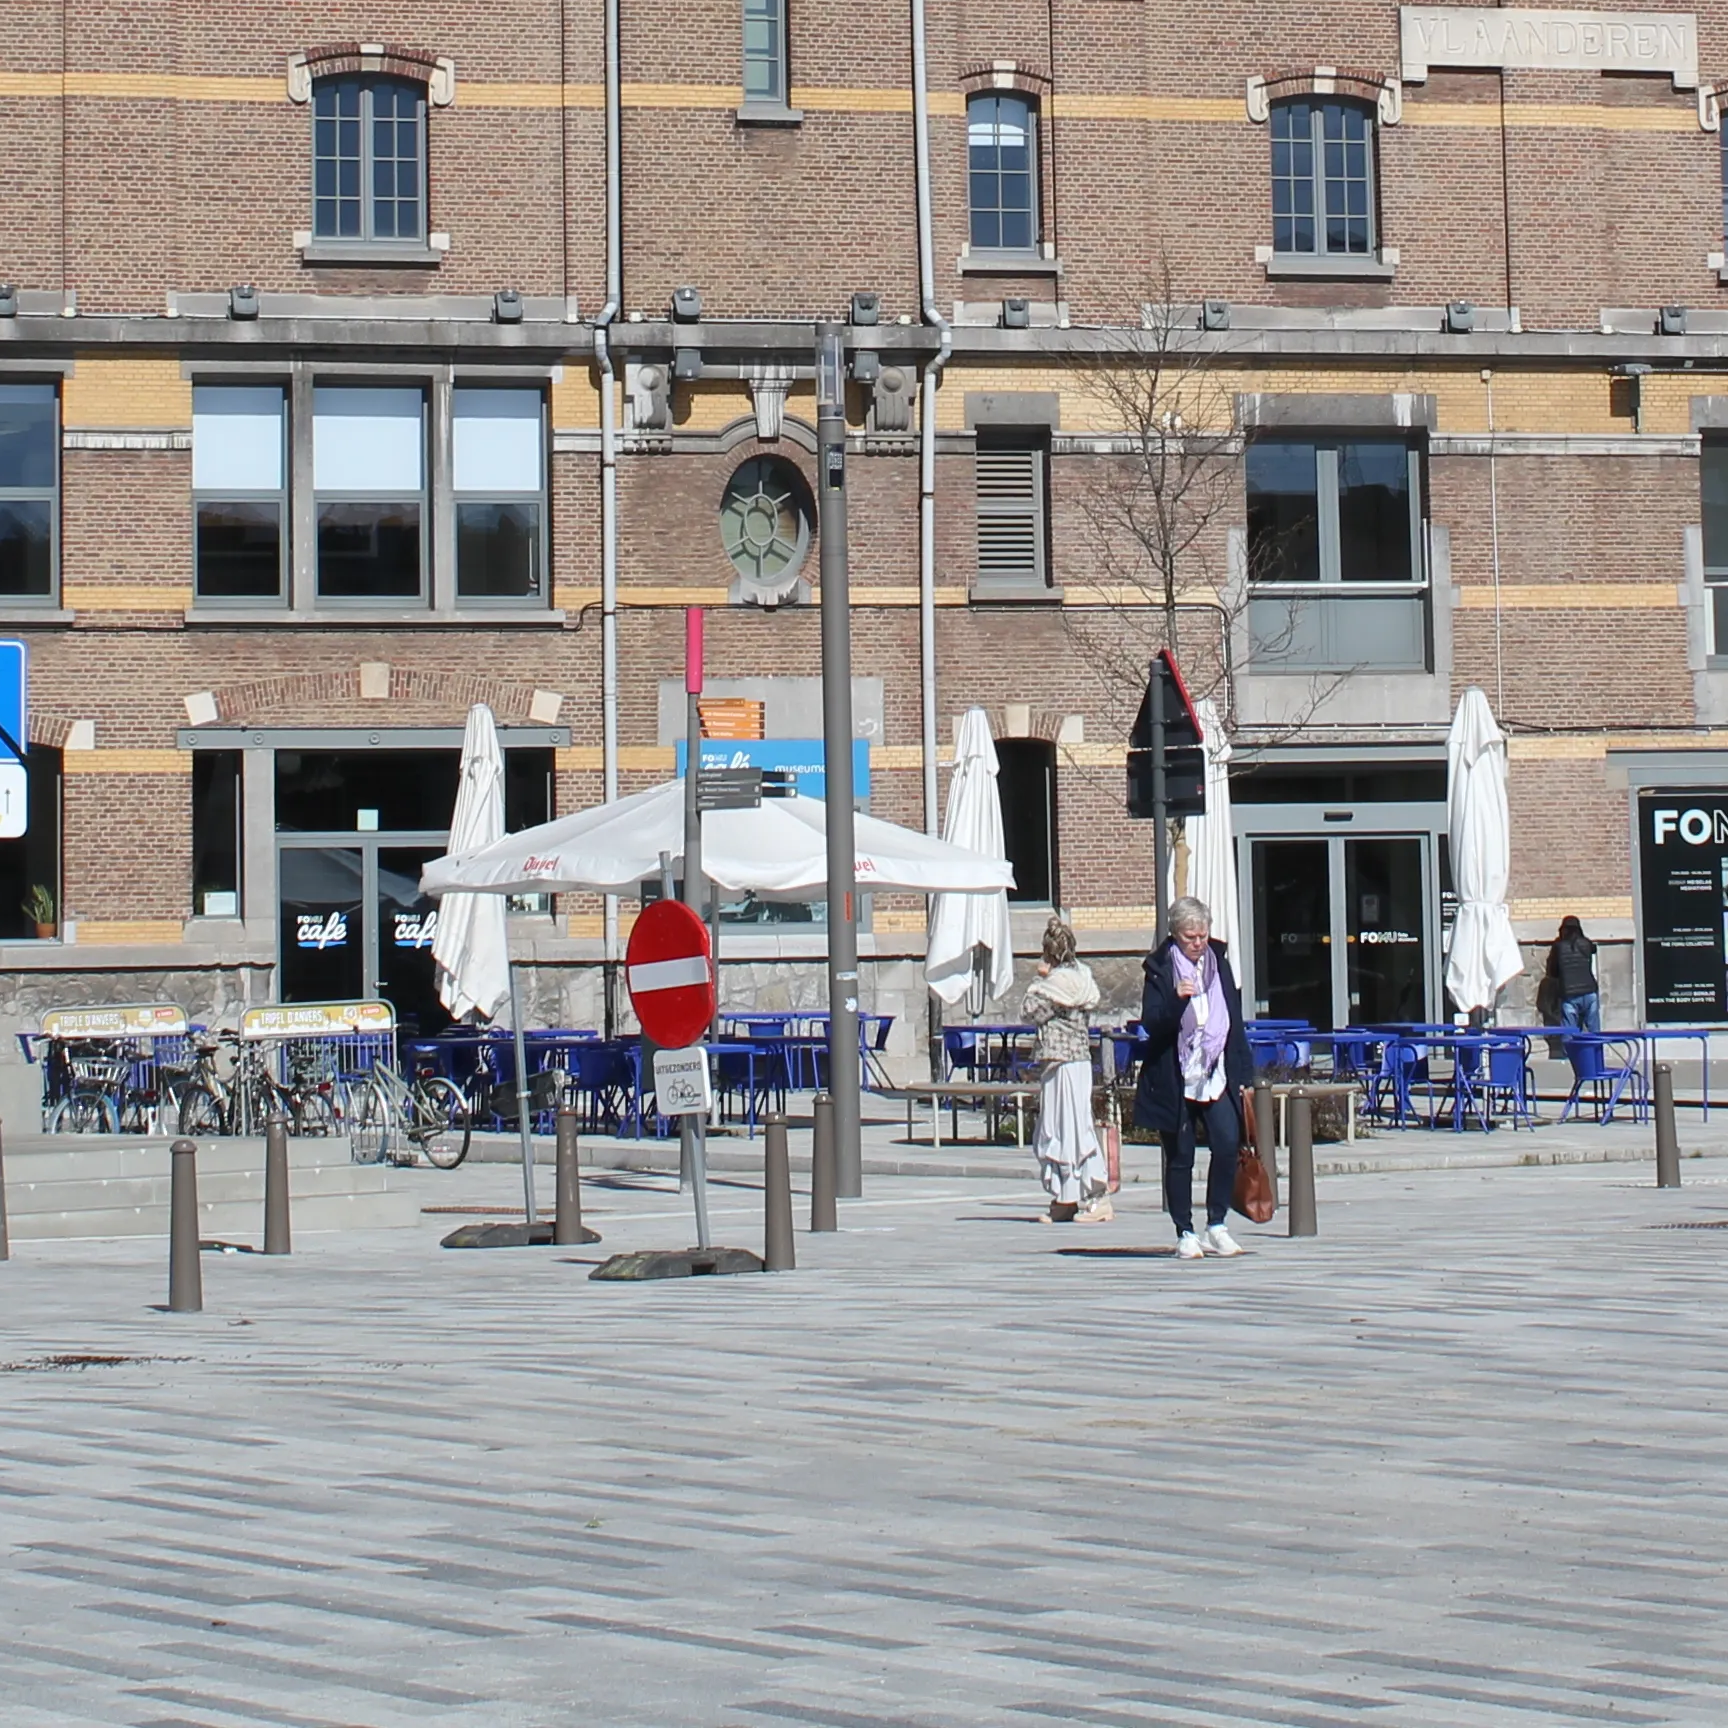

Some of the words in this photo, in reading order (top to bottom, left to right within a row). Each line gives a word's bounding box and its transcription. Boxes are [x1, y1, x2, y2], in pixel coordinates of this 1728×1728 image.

[1412, 16, 1689, 61] VLAANDEREN
[522, 855, 561, 872] Duvel
[296, 911, 348, 950] café
[1359, 931, 1398, 944] FOMU
[59, 1015, 84, 1027] TRIPLE
[84, 1013, 119, 1027] D'ANVERS
[260, 1012, 284, 1025] TRIPEL
[287, 1009, 322, 1024] D'ANVERS
